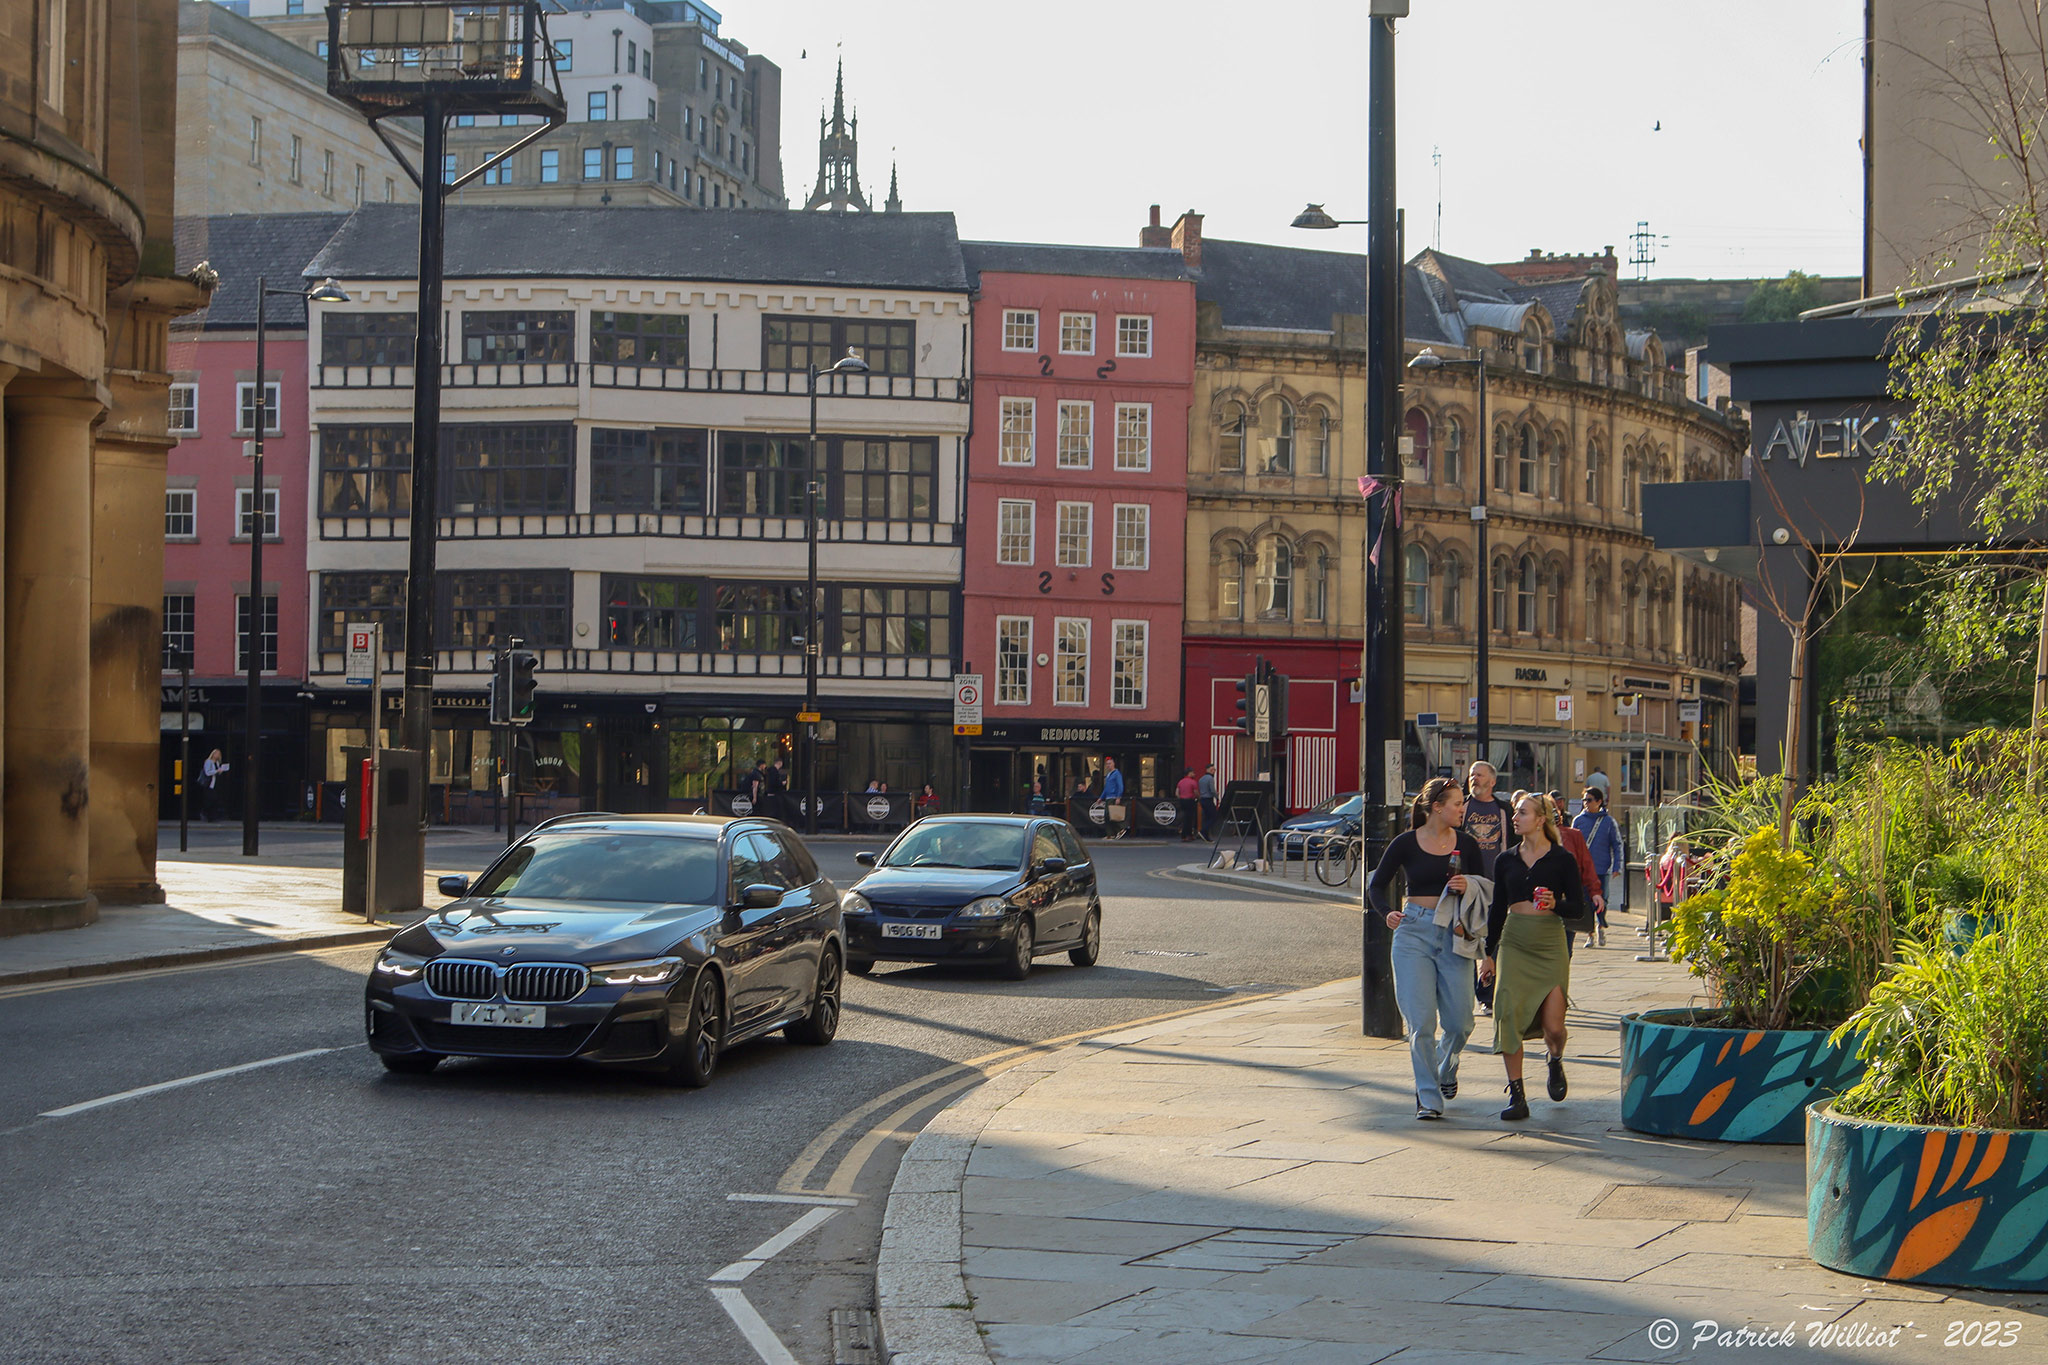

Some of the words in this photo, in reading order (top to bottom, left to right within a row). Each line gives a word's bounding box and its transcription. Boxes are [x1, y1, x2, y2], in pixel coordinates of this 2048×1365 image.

[356, 635, 366, 647] B
[1515, 667, 1547, 681] RASIKA
[1041, 728, 1100, 741] REDHOUSE
[535, 757, 563, 768] LIQUOR
